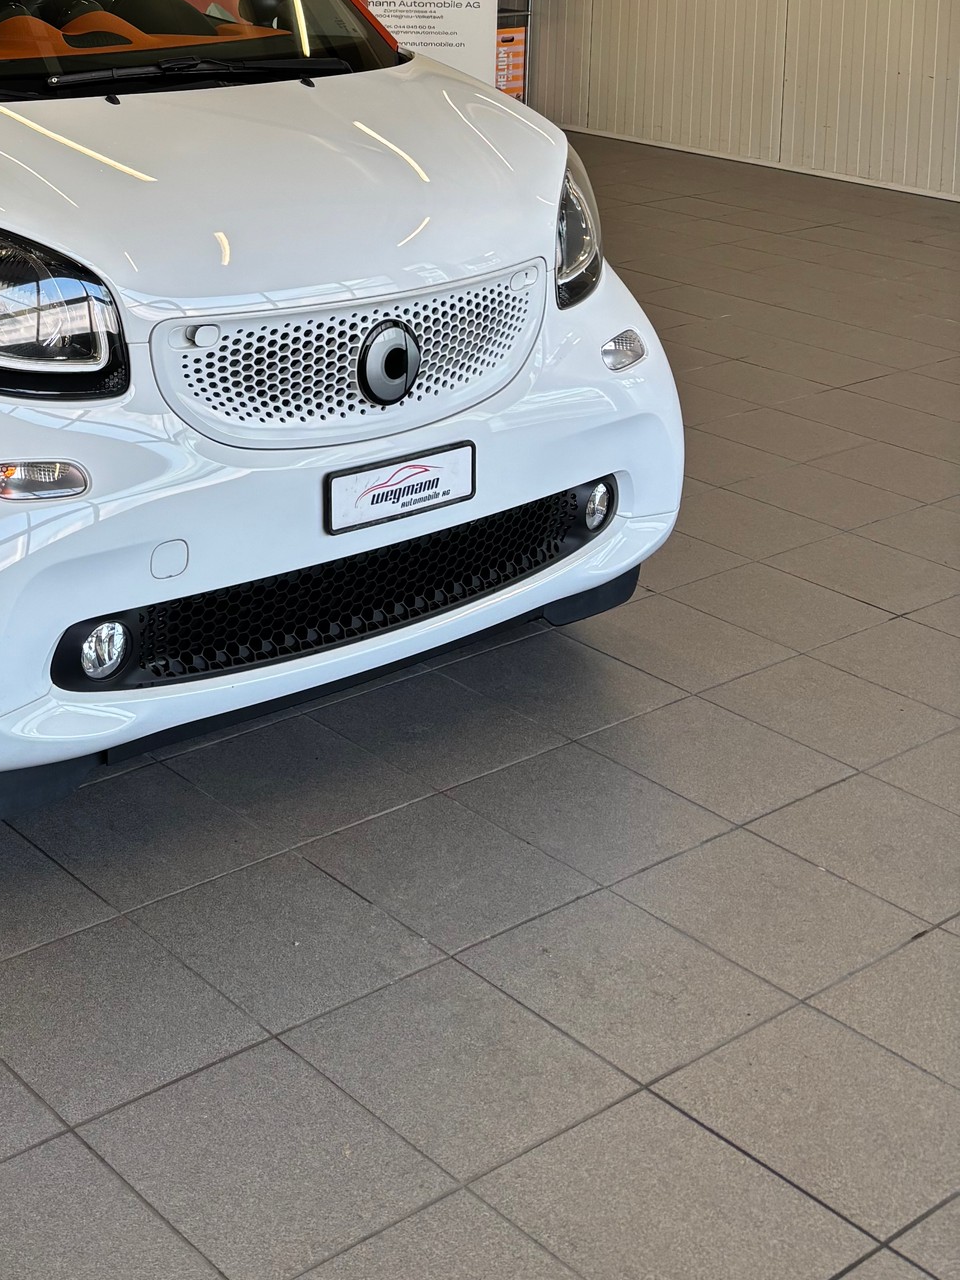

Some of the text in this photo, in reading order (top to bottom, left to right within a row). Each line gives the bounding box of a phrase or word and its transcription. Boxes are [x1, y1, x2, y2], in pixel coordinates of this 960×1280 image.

[368, 0, 481, 9] mann Automobile AG
[496, 47, 508, 90] HELIUM
[370, 477, 440, 506] wegmann
